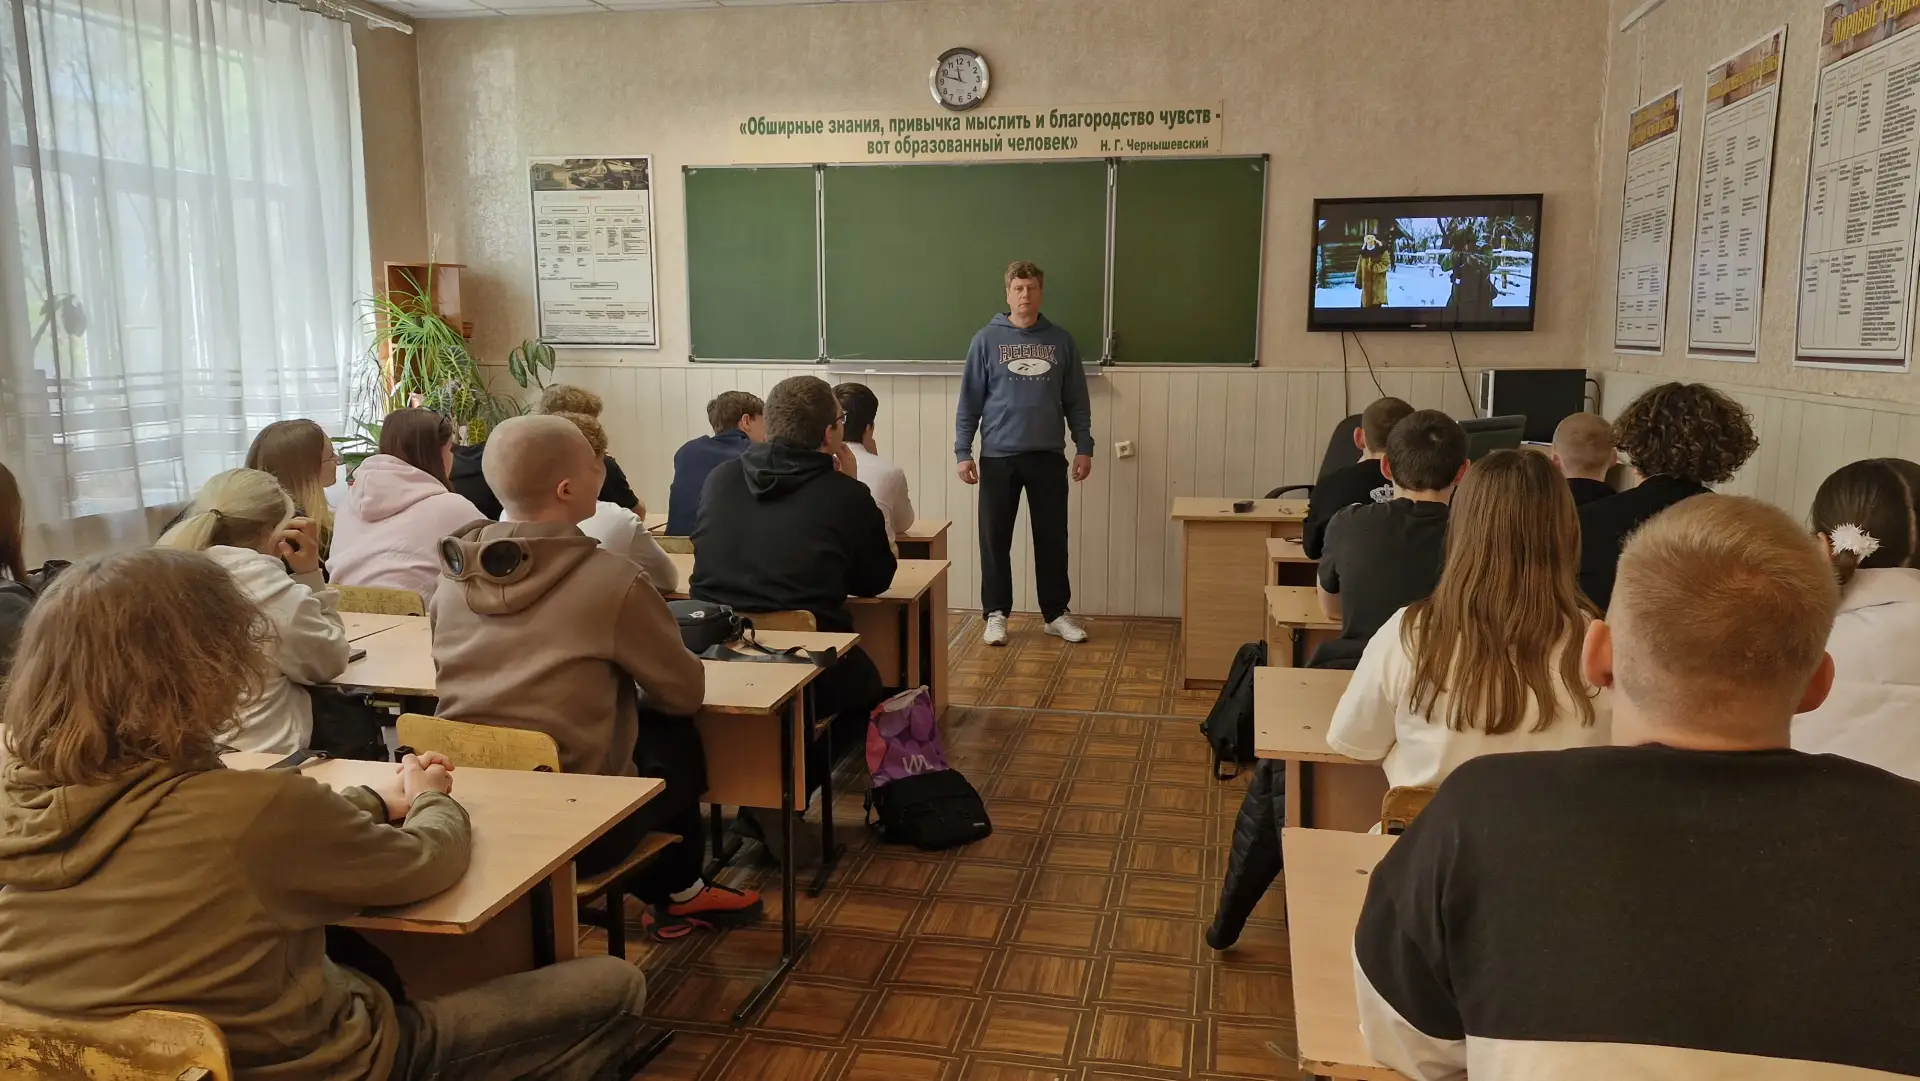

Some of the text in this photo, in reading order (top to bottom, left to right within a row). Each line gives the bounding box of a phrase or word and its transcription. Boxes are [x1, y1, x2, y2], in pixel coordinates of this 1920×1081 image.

[1833, 0, 1920, 45] МИРОВЫЕ РЕЛ
[740, 116, 824, 139] «Обширные
[828, 118, 885, 136] знания,
[889, 116, 960, 136] привычка
[965, 115, 1031, 130] мыслить
[1035, 114, 1045, 128] и
[1049, 108, 1155, 132] благородство
[1159, 109, 1211, 130] чувств
[867, 134, 1078, 158] вот образованный человек»
[1100, 136, 1209, 154] Н. Г. Чернышевский
[998, 344, 1058, 365] REEBOK
